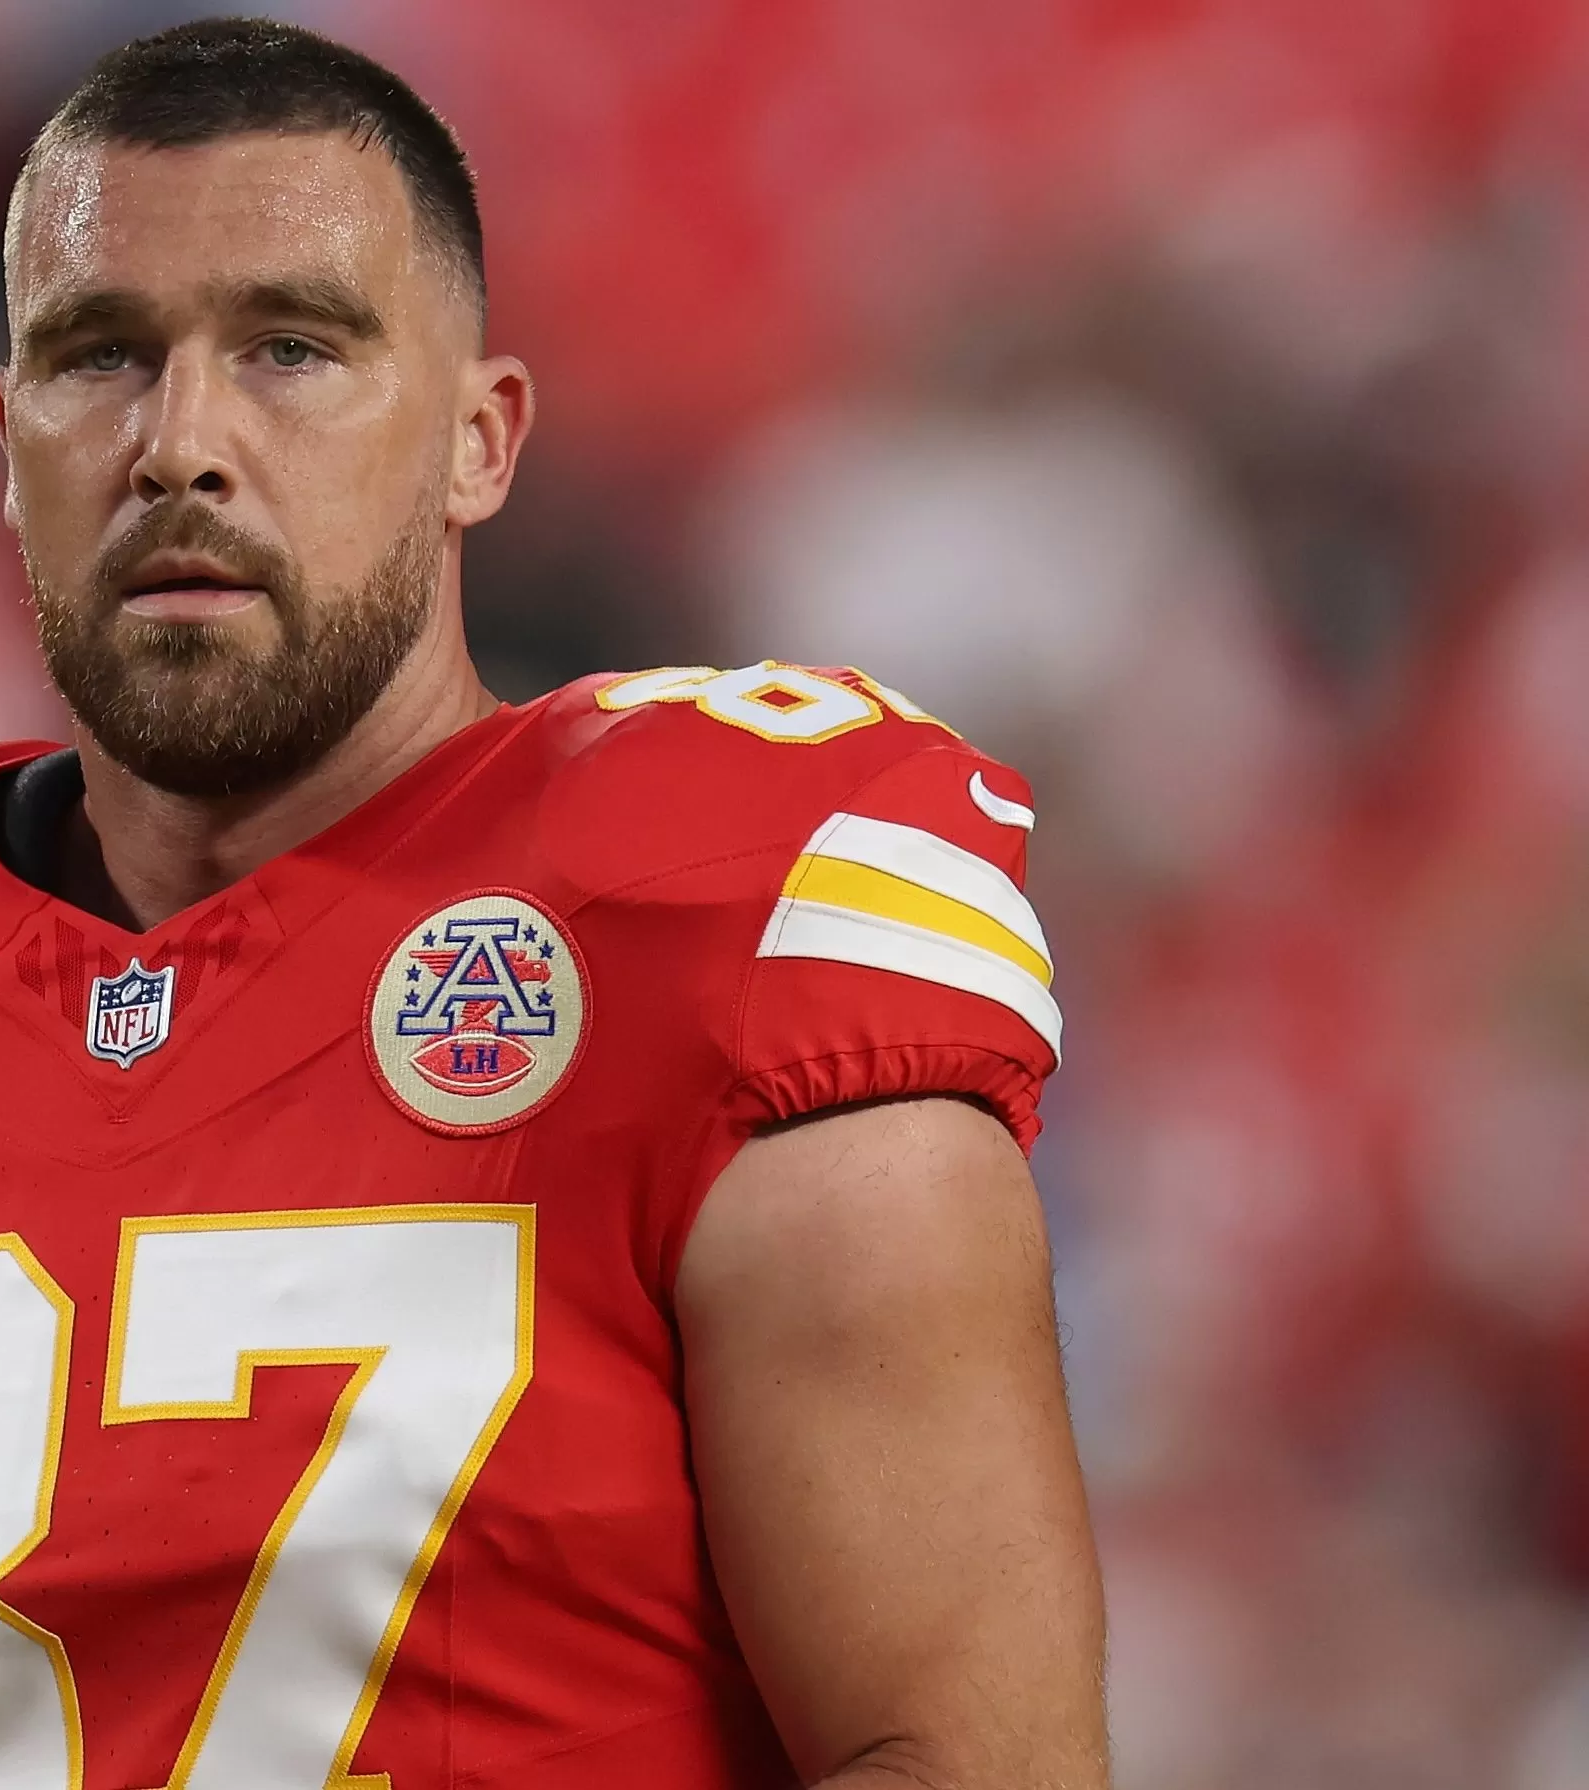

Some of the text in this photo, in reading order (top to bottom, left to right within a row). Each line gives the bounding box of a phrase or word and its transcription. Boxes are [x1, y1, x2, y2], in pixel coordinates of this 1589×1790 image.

[396, 917, 555, 1036] A
[101, 1006, 154, 1047] NFL
[451, 1045, 500, 1074] LH
